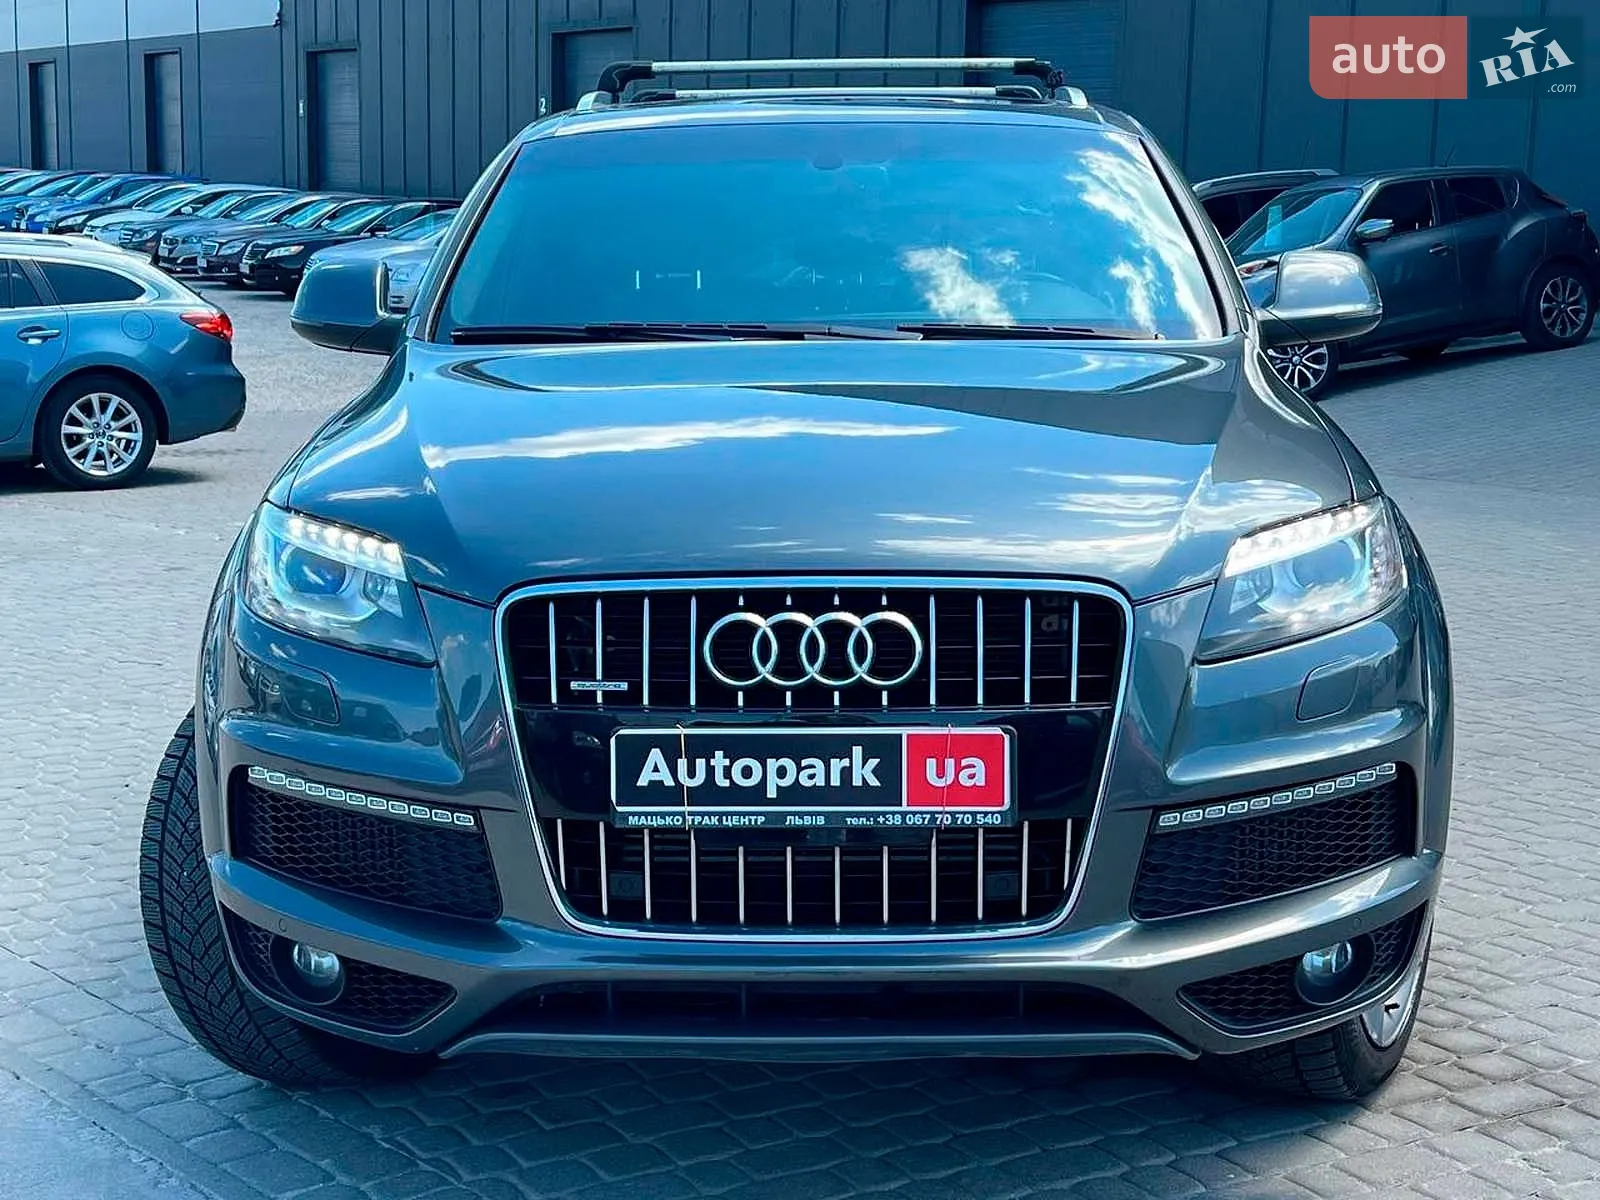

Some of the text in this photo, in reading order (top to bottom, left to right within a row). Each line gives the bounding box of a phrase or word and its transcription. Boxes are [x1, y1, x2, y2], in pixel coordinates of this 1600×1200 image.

[636, 745, 987, 798] Autopark ua
[628, 815, 683, 826] МАЦЬКО
[687, 815, 719, 825] ТРАК
[722, 815, 766, 826] ЦЕНТР
[785, 815, 825, 825] ЛЬВІВ
[877, 814, 902, 825] +38
[906, 814, 931, 825] 067
[955, 814, 972, 825] 70
[976, 814, 1001, 825] 540
